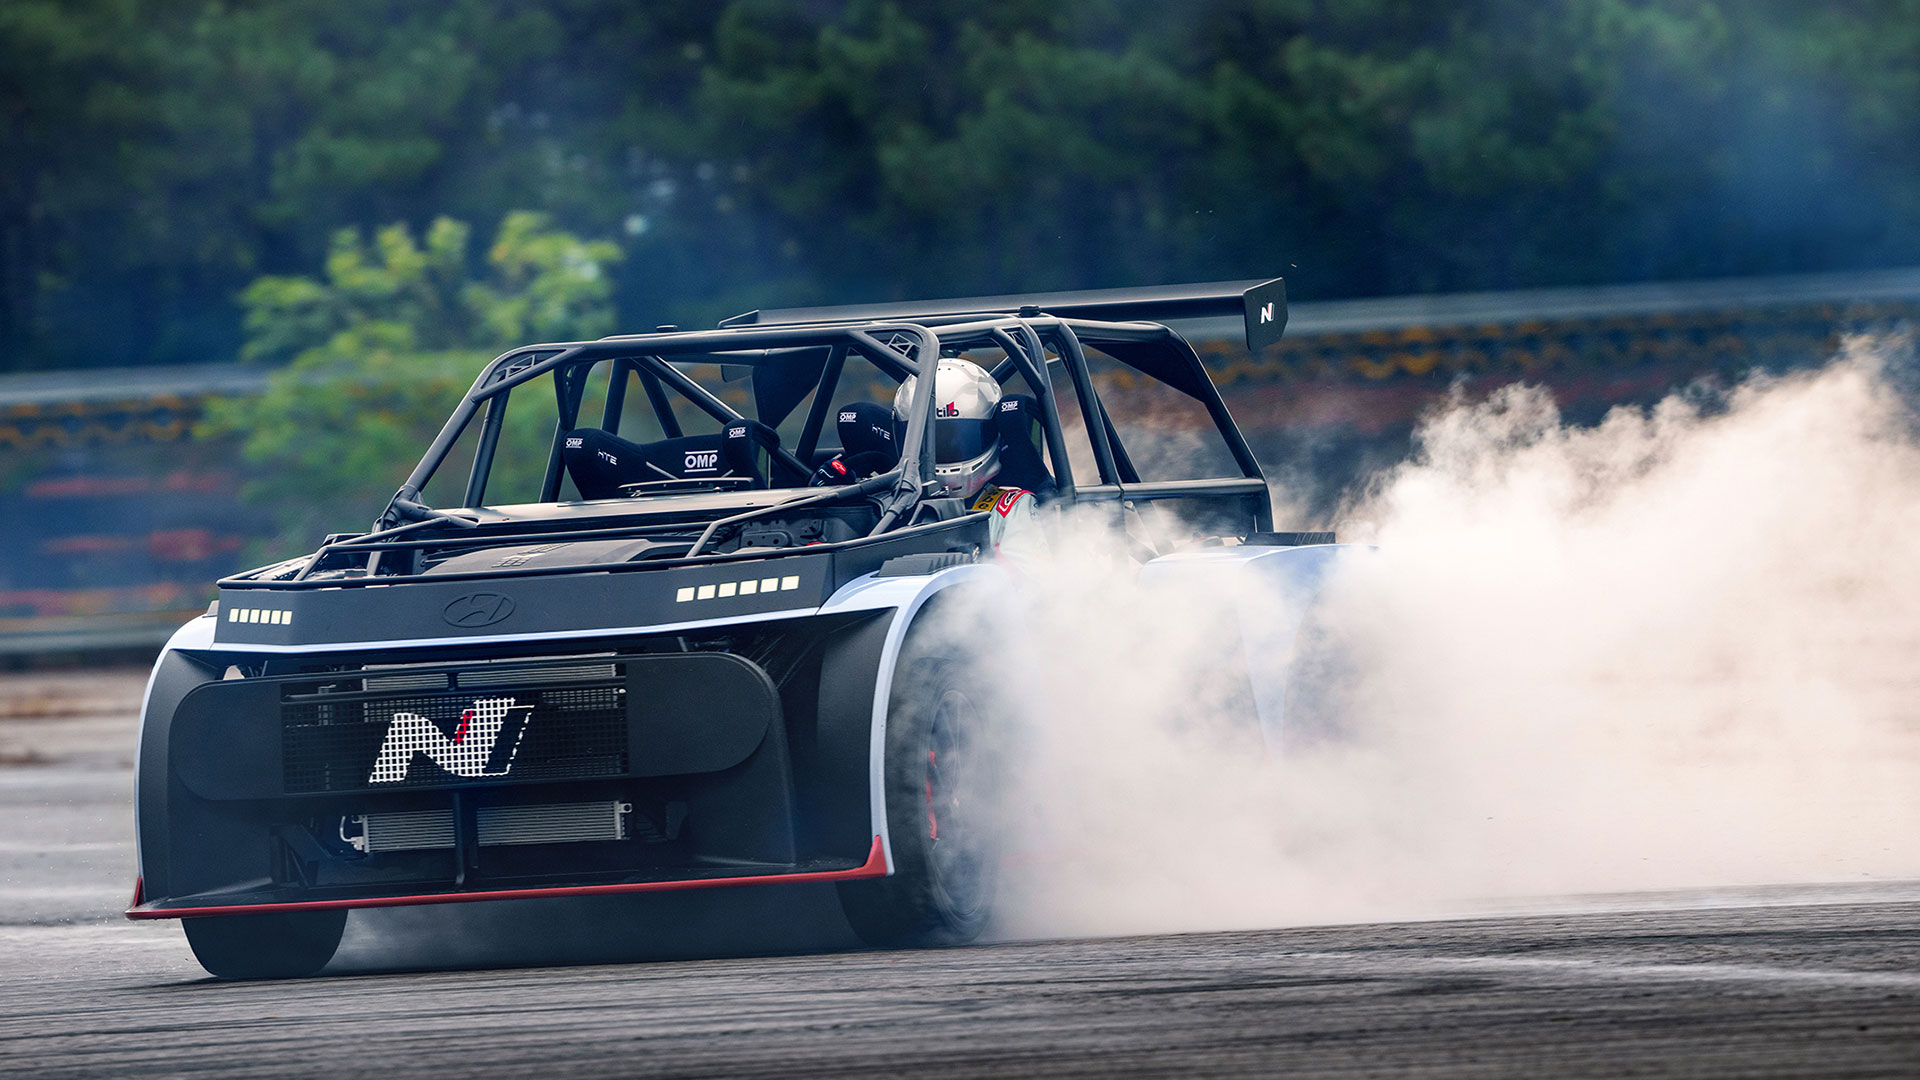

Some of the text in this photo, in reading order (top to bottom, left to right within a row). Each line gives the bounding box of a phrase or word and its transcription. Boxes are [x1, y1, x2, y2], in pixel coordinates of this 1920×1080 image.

[936, 402, 960, 418] tilo
[840, 412, 857, 421] OMP
[729, 428, 746, 437] OMP
[566, 439, 583, 447] OMP
[684, 453, 718, 469] OMP
